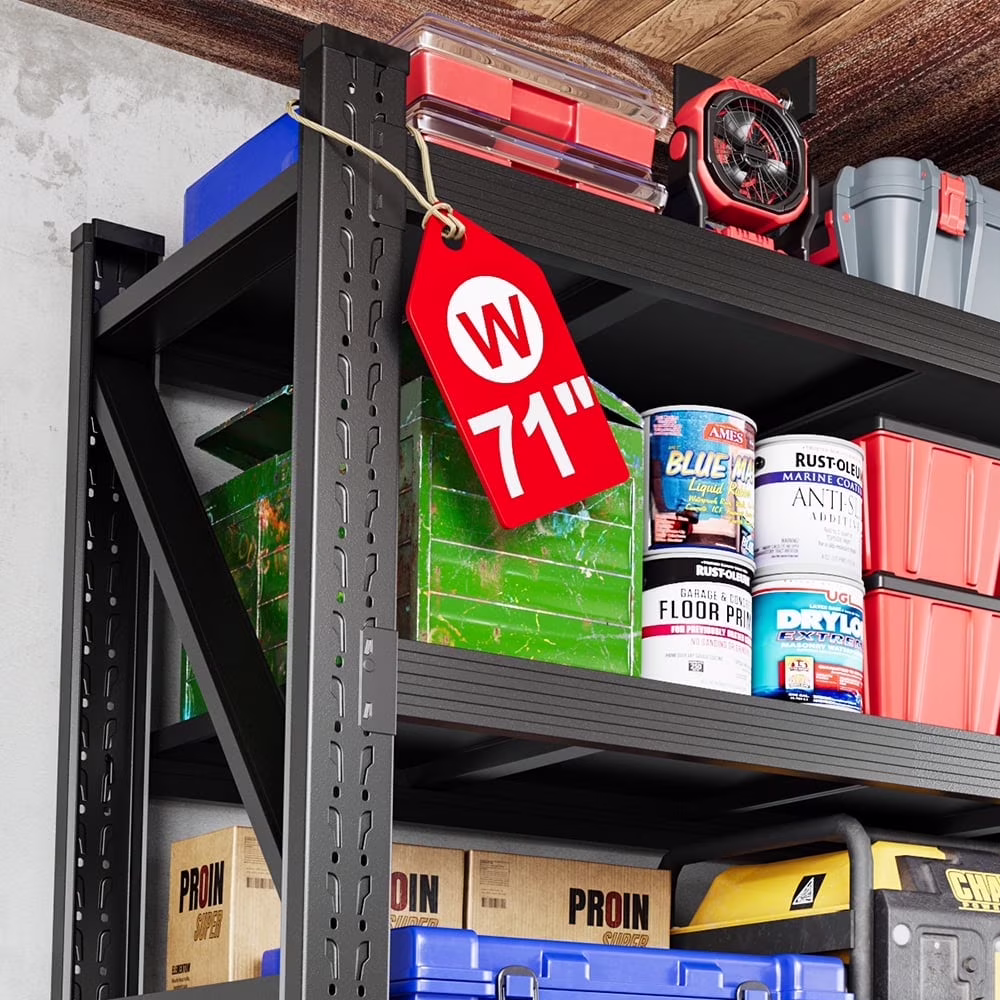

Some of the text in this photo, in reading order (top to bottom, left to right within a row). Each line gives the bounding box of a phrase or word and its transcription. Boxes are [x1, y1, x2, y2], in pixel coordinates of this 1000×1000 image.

[456, 295, 531, 369] W
[467, 375, 595, 499] 71"
[709, 426, 744, 443] AMES
[665, 450, 730, 479] BLUE
[688, 477, 724, 497] Liquid
[782, 472, 833, 484] MARINE
[680, 588, 718, 601] GARAGE
[720, 592, 728, 602] &
[827, 591, 852, 603] UGL
[659, 600, 720, 621] FLOOR
[179, 860, 225, 914] PROIN
[569, 887, 649, 931] PROIN
[193, 909, 224, 942] SUPER
